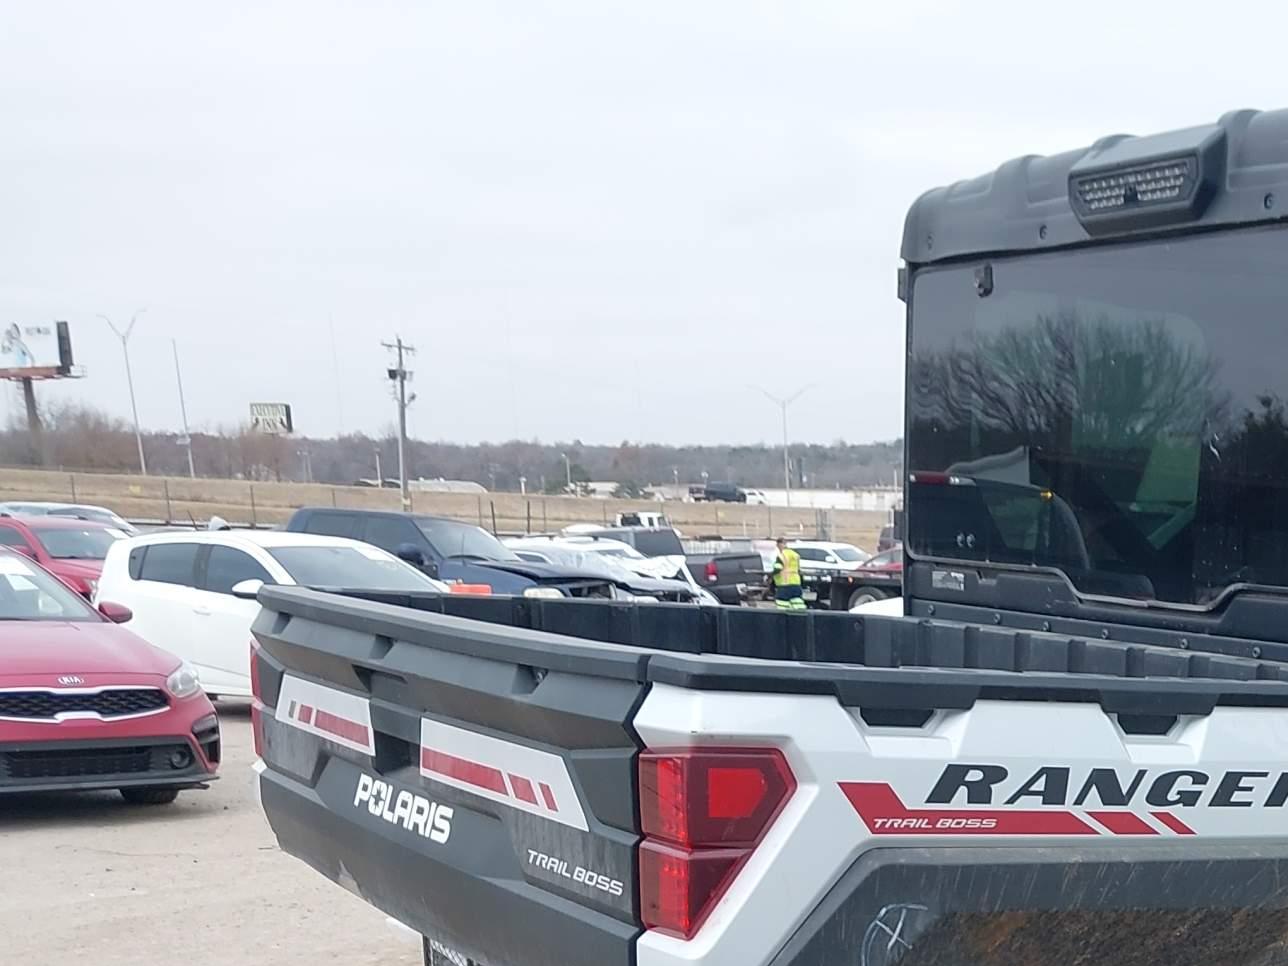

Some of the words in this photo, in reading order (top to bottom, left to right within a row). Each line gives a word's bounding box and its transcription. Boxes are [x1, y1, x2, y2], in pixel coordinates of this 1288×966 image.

[353, 772, 454, 845] POLARIS
[873, 818, 933, 829] TRAIL
[936, 818, 997, 829] BOSS
[527, 848, 571, 877] TRAIL
[571, 866, 624, 897] BOSS
